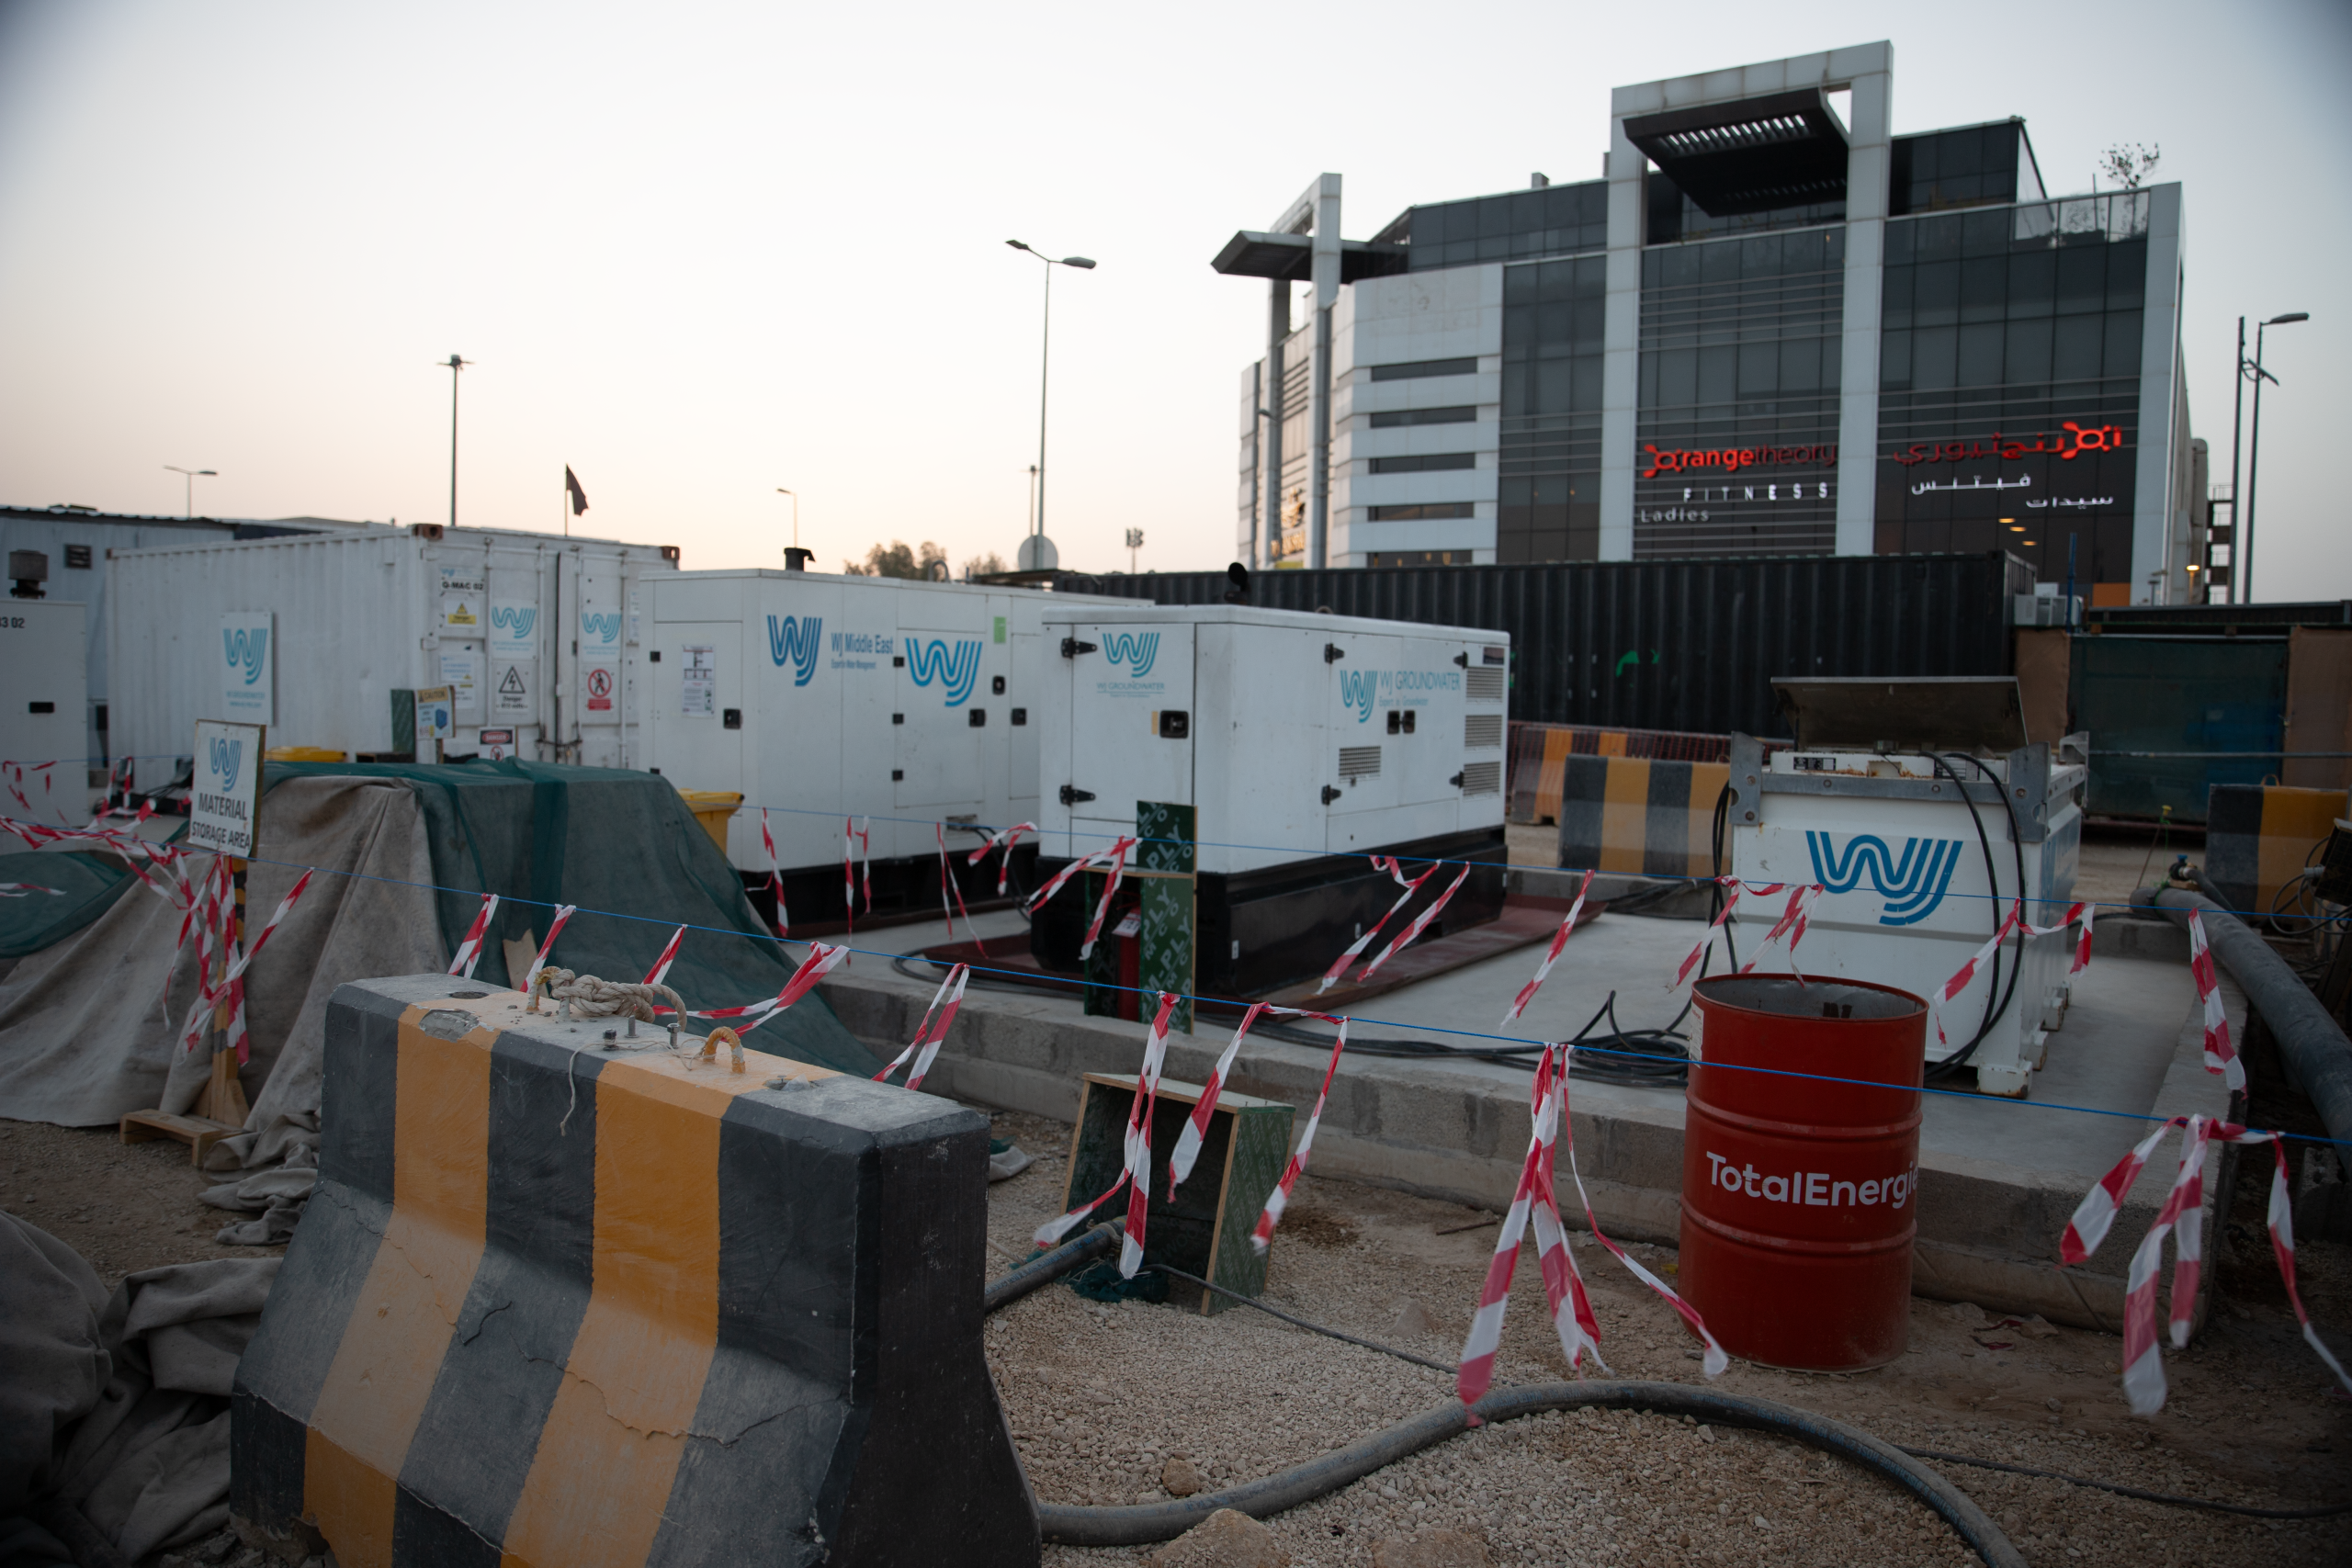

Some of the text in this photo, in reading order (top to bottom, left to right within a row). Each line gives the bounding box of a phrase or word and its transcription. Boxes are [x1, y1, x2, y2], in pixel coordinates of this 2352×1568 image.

[1683, 481, 1828, 503] FITNESS
[1911, 474, 2031, 496] فيتنس
[2026, 496, 2113, 510] سيدات
[1640, 507, 1710, 524] Ladies
[11, 617, 25, 628] 02
[845, 633, 873, 653] Middle
[875, 635, 893, 655] East
[1379, 671, 1461, 695] WJ GROUNDWATER
[198, 793, 247, 820] MATERIAL
[192, 821, 251, 850] STORAGE AREA
[1059, 1243, 1079, 1258] HOSE
[1691, 1393, 1722, 1405] THAILAND
[1723, 1398, 1730, 1408] IN
[1731, 1399, 1749, 1411] MADE
[1757, 1407, 1773, 1420] PSI
[1775, 1412, 1791, 1425] 150
[1798, 1418, 1816, 1434] BAR
[1818, 1427, 1827, 1438] 10
[1829, 1432, 1845, 1447] WP
[1856, 1443, 1880, 1463] HOSE
[1879, 1455, 1923, 1492] DISCHARGE
